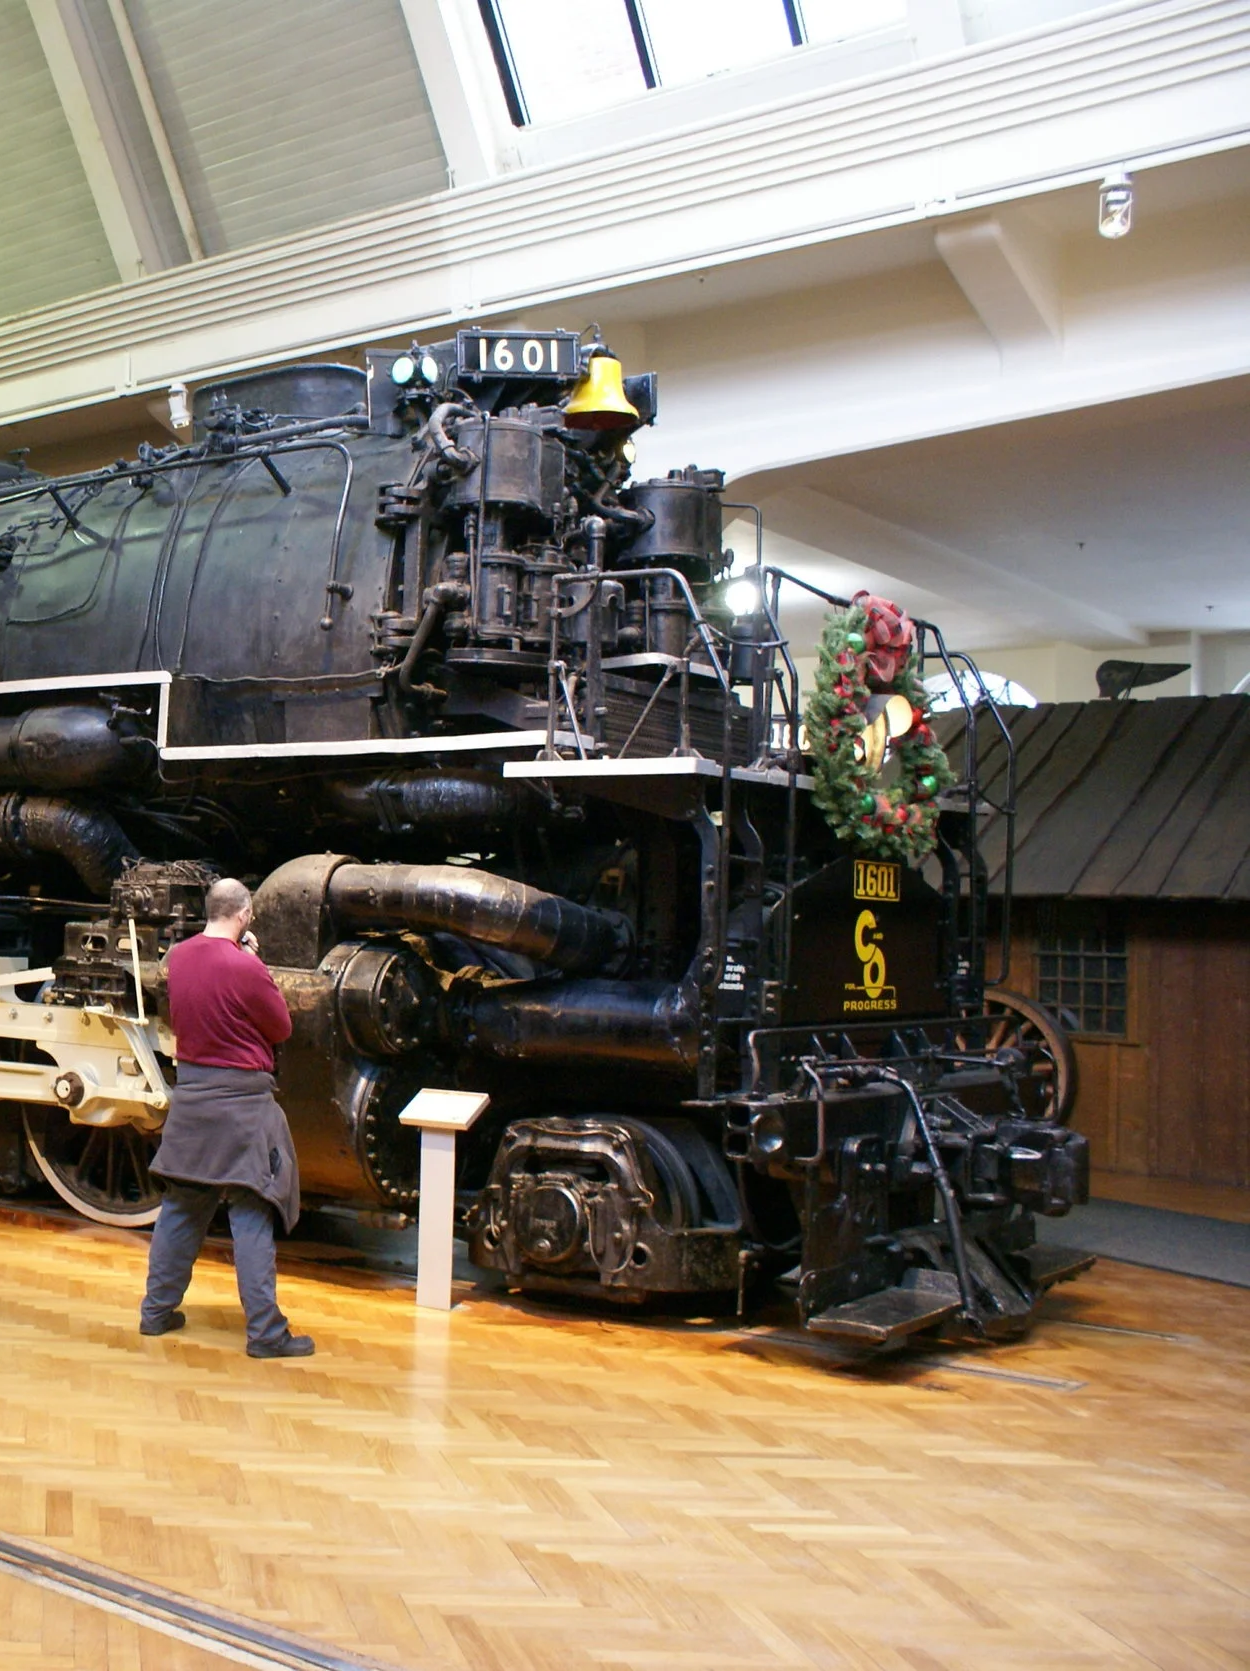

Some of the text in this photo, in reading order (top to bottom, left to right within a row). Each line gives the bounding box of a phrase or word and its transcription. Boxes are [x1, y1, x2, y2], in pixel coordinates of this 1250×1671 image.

[479, 338, 558, 372] 1601
[857, 863, 896, 898] 1601
[843, 1000, 897, 1012] PROGRESS
